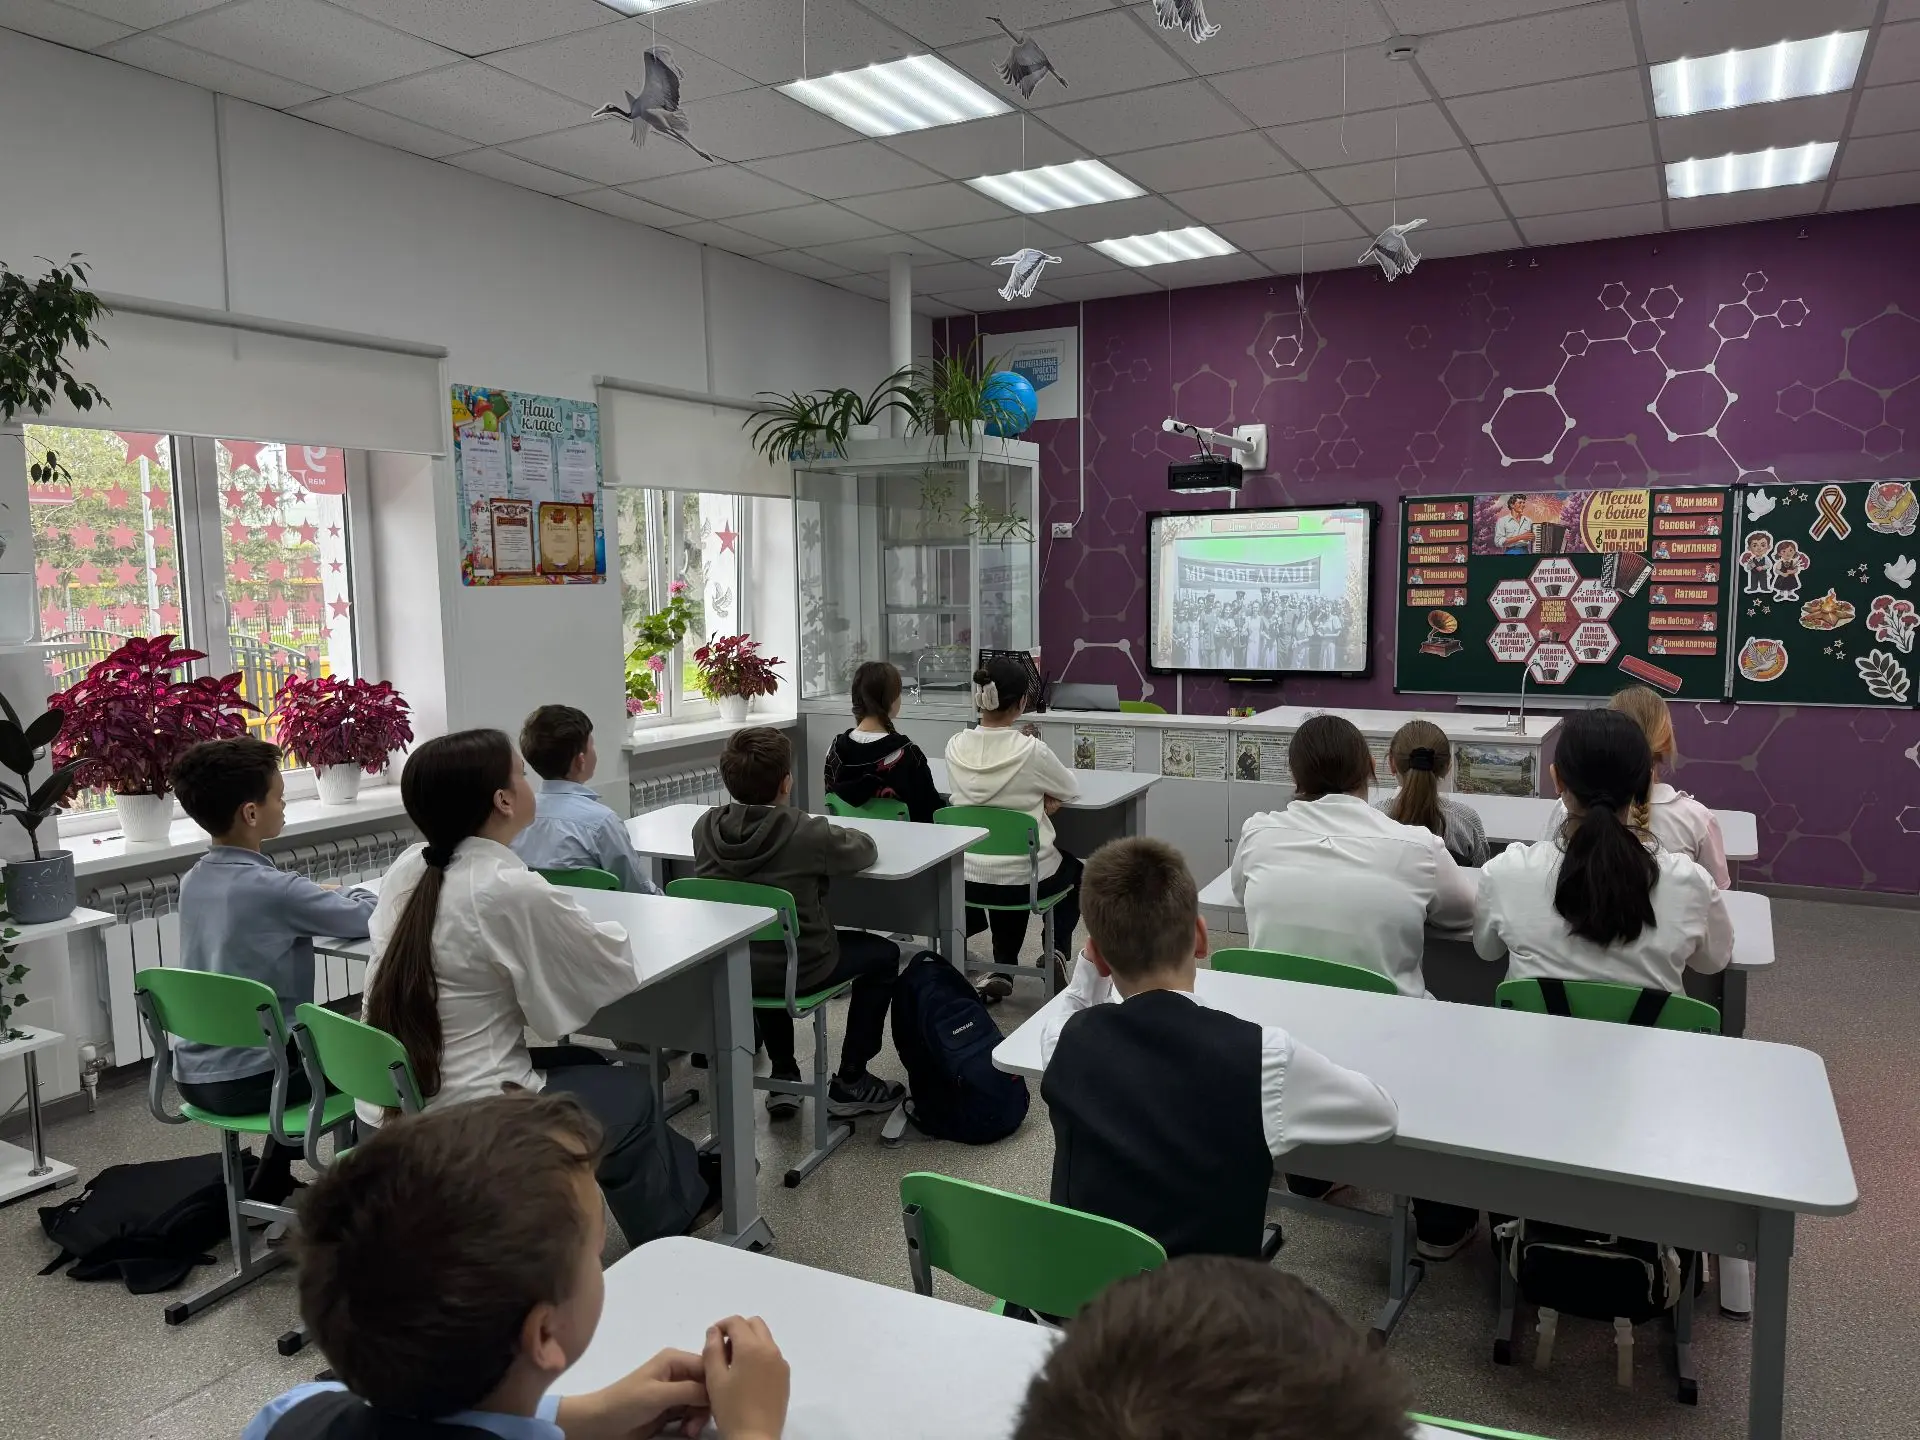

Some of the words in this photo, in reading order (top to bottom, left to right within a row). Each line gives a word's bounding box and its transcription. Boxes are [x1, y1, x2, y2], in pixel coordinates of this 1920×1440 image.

[1032, 366, 1057, 375] ПРОЕКТЫ
[520, 399, 555, 419] Наш
[522, 417, 563, 433] класс
[1600, 491, 1643, 505] Песни
[1675, 496, 1694, 507] Жди
[1696, 497, 1718, 507] меня
[1424, 503, 1436, 513] Три
[1594, 509, 1602, 519] о
[1605, 505, 1646, 519] войне
[1414, 512, 1446, 521] танкиста
[1659, 519, 1696, 530] Соловьи
[1429, 529, 1459, 539] Журавли
[1604, 529, 1617, 540] КО
[1620, 528, 1645, 540] ДНЮ
[1603, 541, 1646, 552] ПОБЕДЫ
[1671, 542, 1717, 554] Смуглянка
[1423, 569, 1448, 579] Тёмная
[1448, 570, 1465, 579] ночь
[1658, 568, 1697, 576] землянке
[1674, 588, 1708, 599] Катюша
[1650, 616, 1667, 626] День
[1667, 616, 1694, 626] Победы
[1663, 639, 1685, 648] Синий
[1685, 641, 1717, 649] платочек
